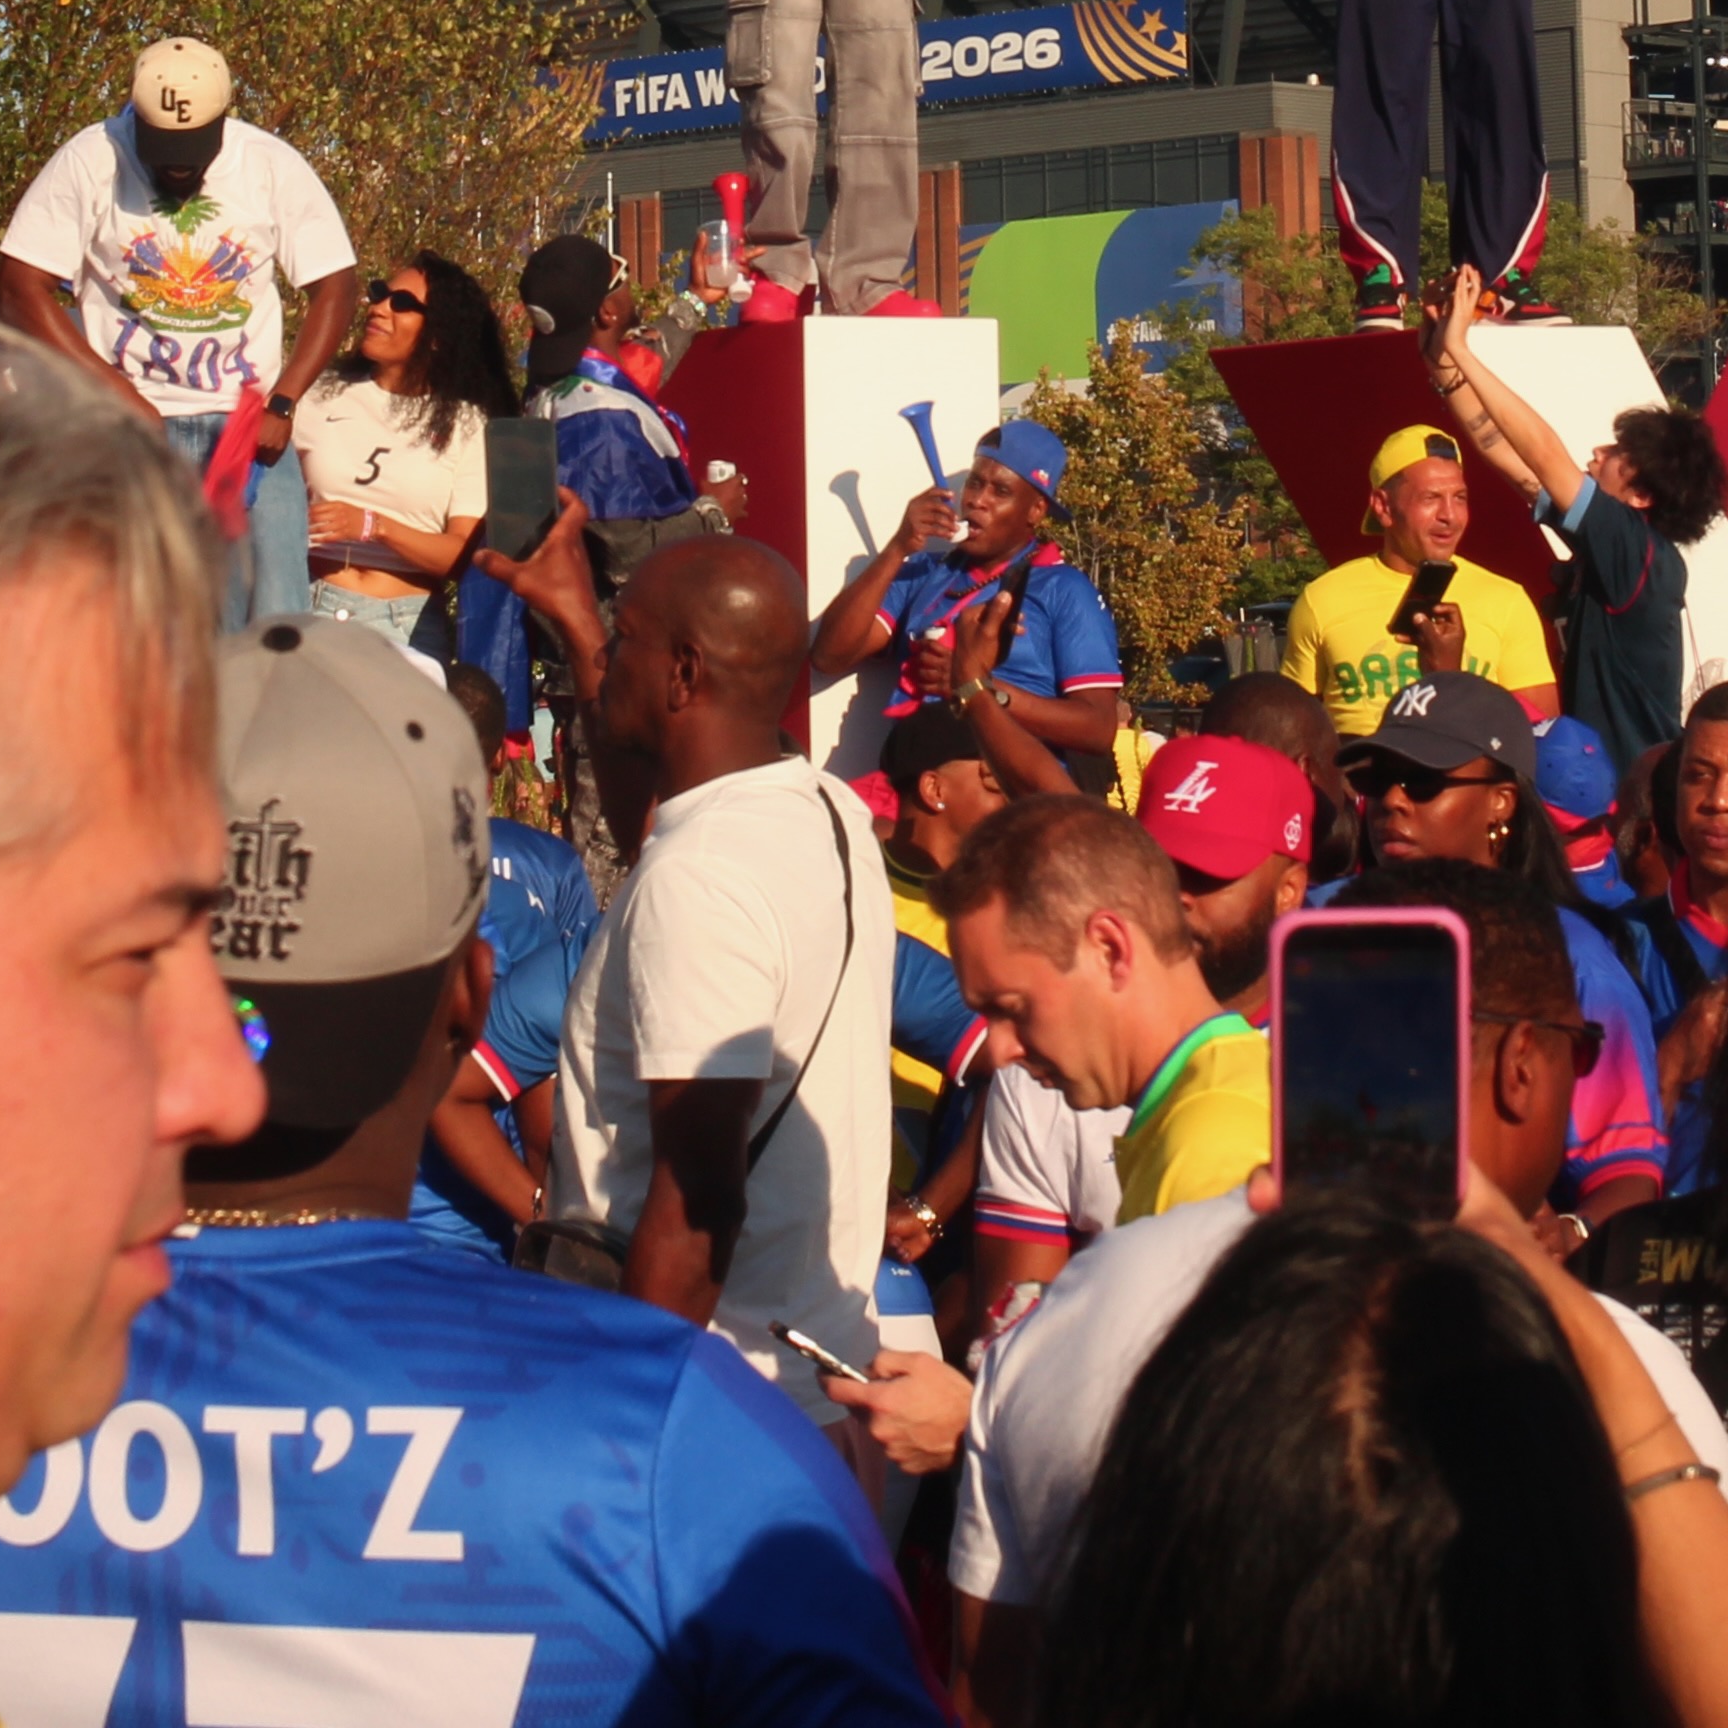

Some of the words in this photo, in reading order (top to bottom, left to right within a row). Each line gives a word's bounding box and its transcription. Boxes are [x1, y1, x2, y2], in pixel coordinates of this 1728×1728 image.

[615, 72, 692, 117] FIFA
[921, 27, 1062, 81] 2026
[112, 317, 260, 393] 1804
[354, 447, 391, 485] 5
[1393, 684, 1437, 716] NY
[1164, 761, 1219, 813] LA
[210, 917, 300, 960] ear
